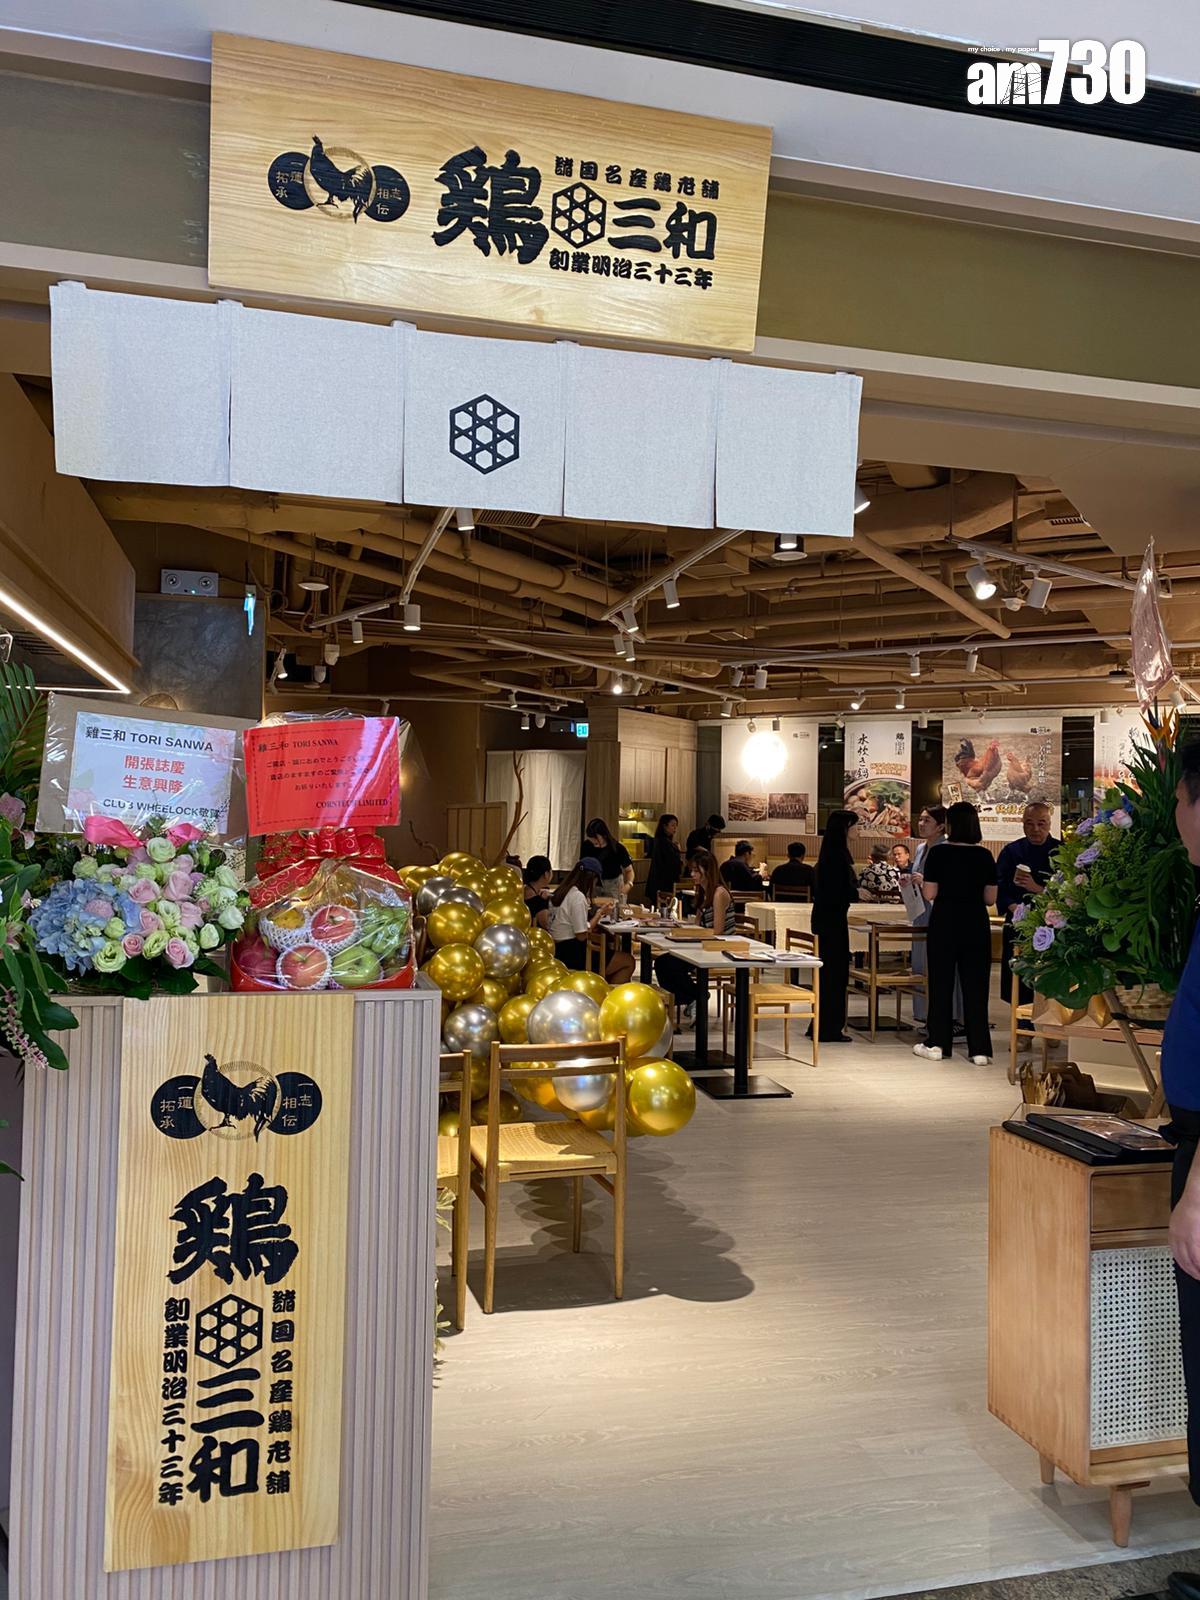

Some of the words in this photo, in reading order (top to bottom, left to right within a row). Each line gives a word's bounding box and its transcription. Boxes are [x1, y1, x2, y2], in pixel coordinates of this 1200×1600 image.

[549, 248, 713, 290] 創業明治三十三年
[130, 732, 161, 746] TORI
[165, 737, 213, 752] SANWA
[293, 739, 310, 749] TORI
[312, 738, 339, 747] SANWA
[124, 755, 185, 775] 開張誌慶
[122, 774, 183, 794] 生意興隆
[358, 798, 388, 807] LIMITED
[158, 1297, 190, 1506] 創業明治三十三年
